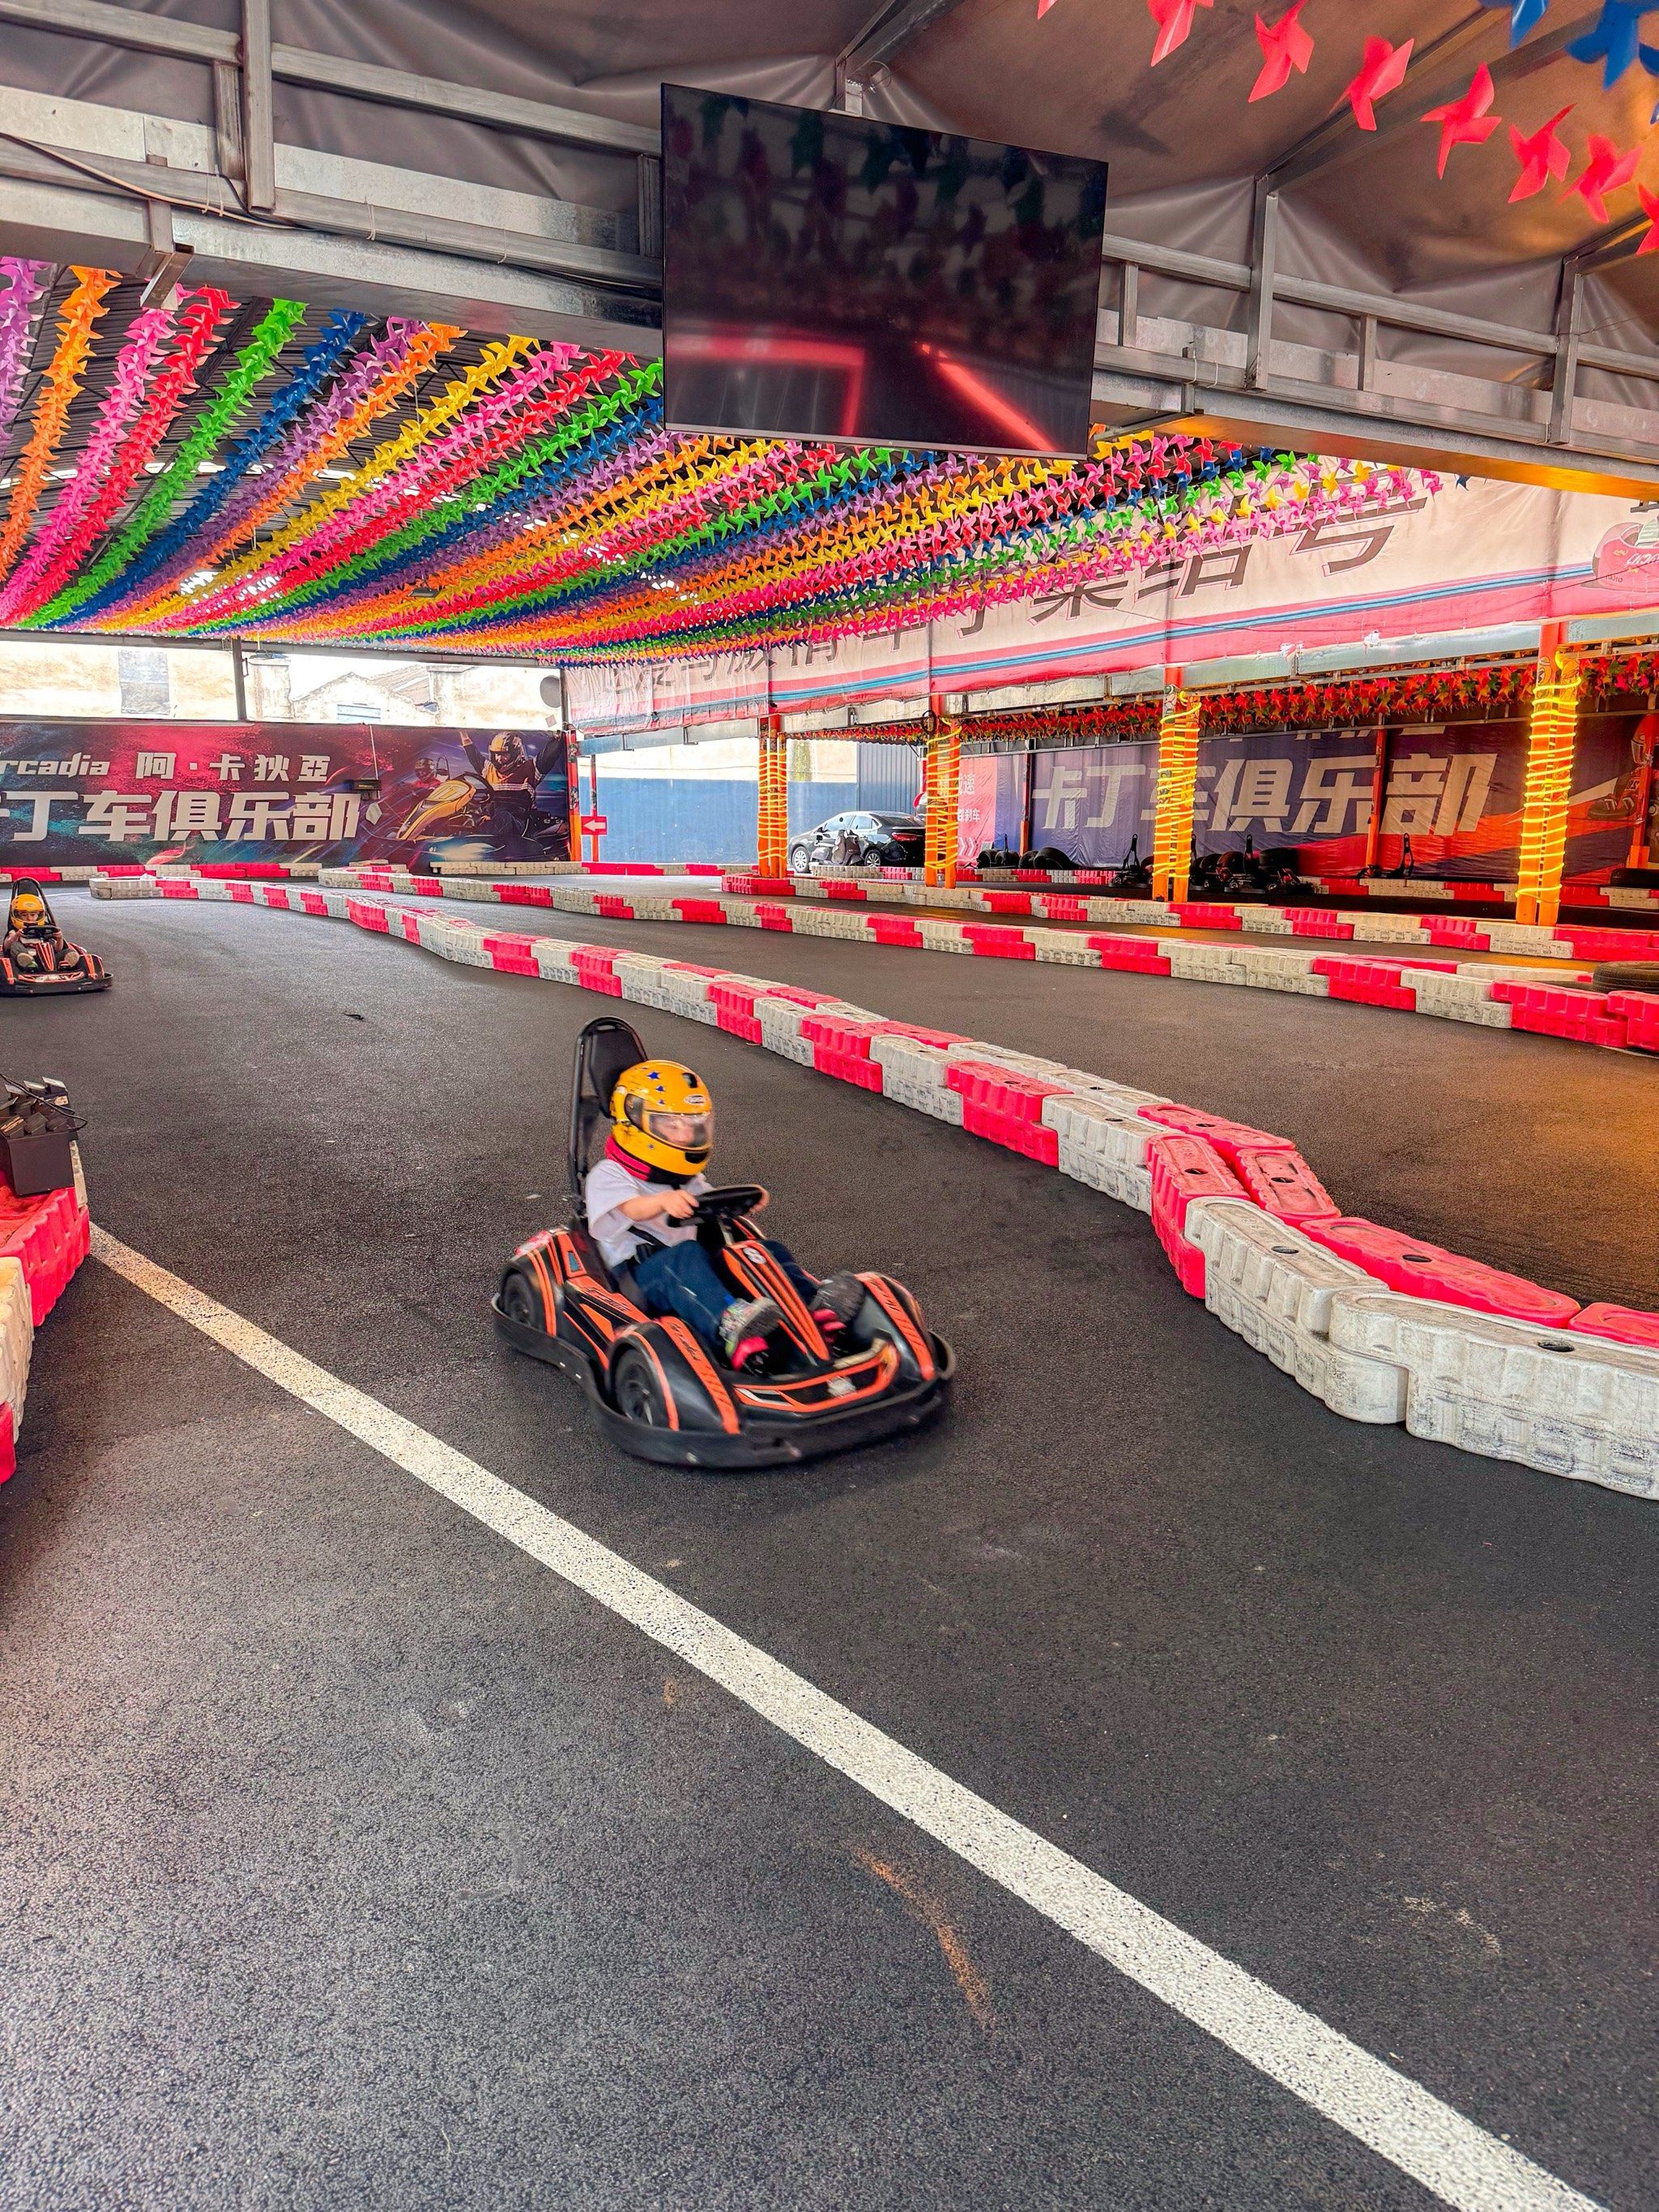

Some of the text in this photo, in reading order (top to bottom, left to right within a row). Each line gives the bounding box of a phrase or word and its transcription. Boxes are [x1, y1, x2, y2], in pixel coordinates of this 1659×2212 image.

[0, 752, 110, 777] rcadia
[0, 789, 361, 842] 丁车俱乐部
[742, 1247, 766, 1264] 8
